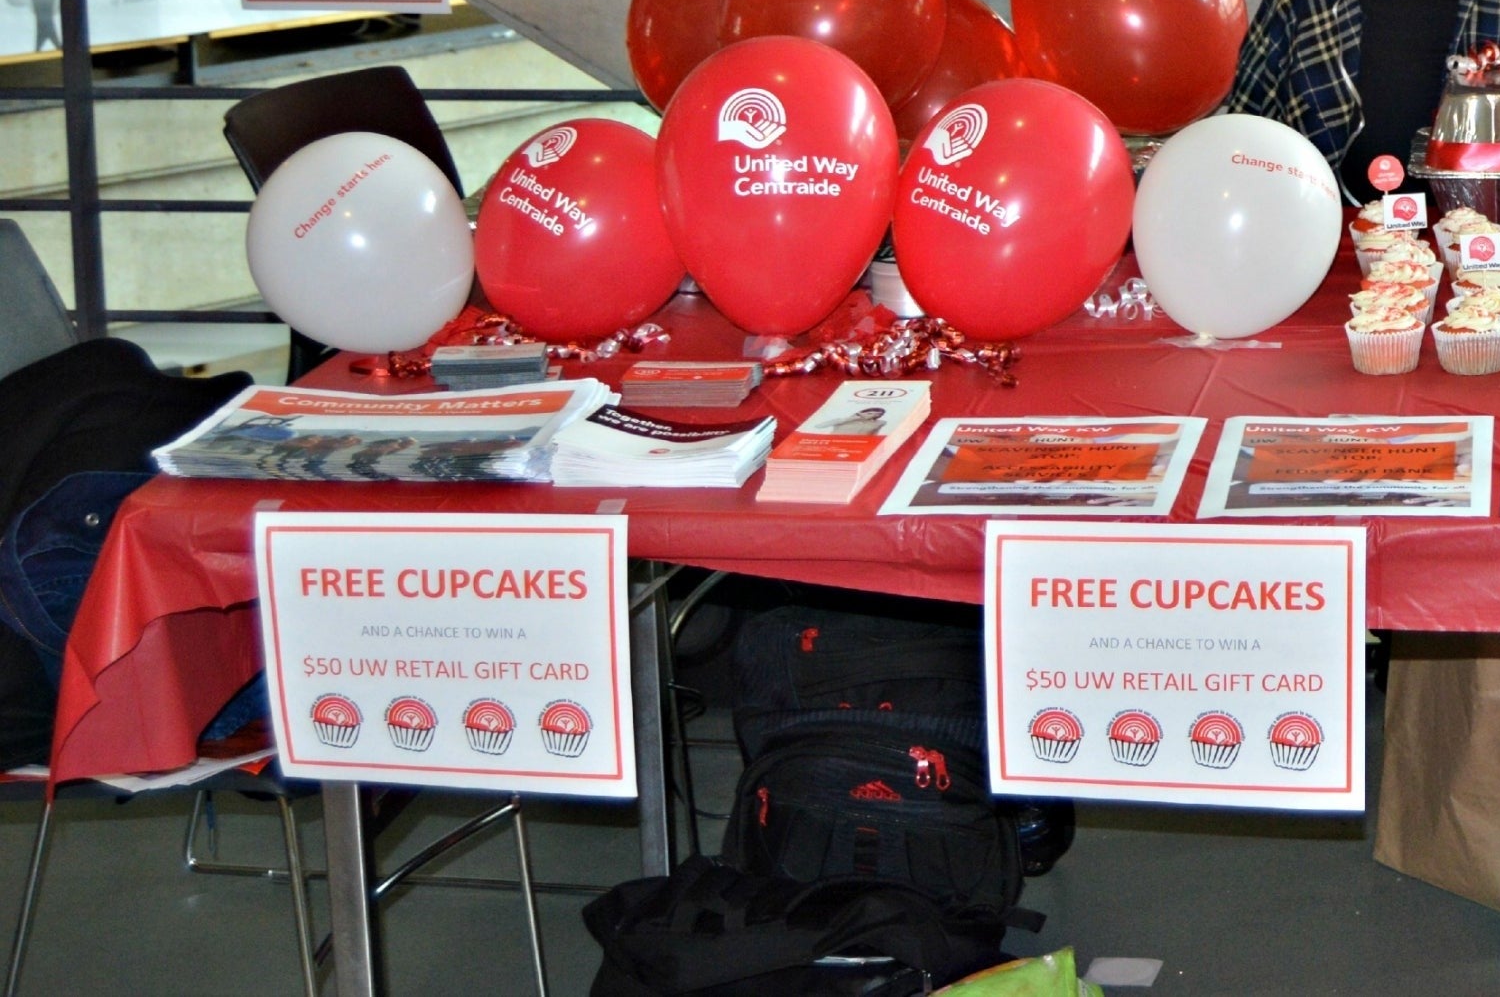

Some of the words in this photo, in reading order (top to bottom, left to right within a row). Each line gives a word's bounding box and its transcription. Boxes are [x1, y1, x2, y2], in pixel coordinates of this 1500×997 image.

[734, 154, 807, 174] United
[813, 156, 859, 181] Way
[1232, 154, 1283, 172] Change
[295, 195, 336, 239] Change
[337, 169, 369, 199] starts
[367, 151, 393, 175] here.
[734, 176, 841, 196] Centraide
[918, 166, 972, 201] United
[975, 192, 1021, 227] Way
[499, 186, 564, 236] Centraide
[510, 168, 555, 201] United
[555, 190, 595, 231] Way
[911, 188, 990, 235] Centraide
[278, 395, 428, 413] Community
[438, 395, 543, 410] Matters
[1075, 425, 1114, 433] KW
[1245, 425, 1311, 433] United
[1316, 426, 1361, 434] Way
[301, 568, 385, 597] FREE
[397, 569, 587, 599] CUPCAKES
[1031, 578, 1117, 608] FREE
[1130, 579, 1325, 611] CUPCAKES
[361, 625, 390, 637] AND
[393, 626, 403, 637] A
[406, 626, 460, 639] CHANCE
[463, 627, 482, 639] TO
[485, 628, 513, 639] WIN
[517, 628, 526, 639] A
[1089, 637, 1120, 649] AND
[1123, 638, 1133, 649] A
[1136, 638, 1192, 650] CHANCE
[1196, 639, 1215, 651] TO
[1218, 639, 1247, 651] WIN
[1251, 639, 1261, 651] A
[303, 655, 342, 677] $50
[349, 658, 388, 677] UW
[395, 659, 468, 679] RETAIL
[474, 661, 522, 680] GIFT
[529, 662, 589, 680] CARD
[1026, 668, 1066, 691] $50
[1075, 671, 1115, 690] UW
[1123, 672, 1198, 691] RETAIL
[1205, 673, 1255, 692] GIFT
[1262, 674, 1323, 692] CARD
